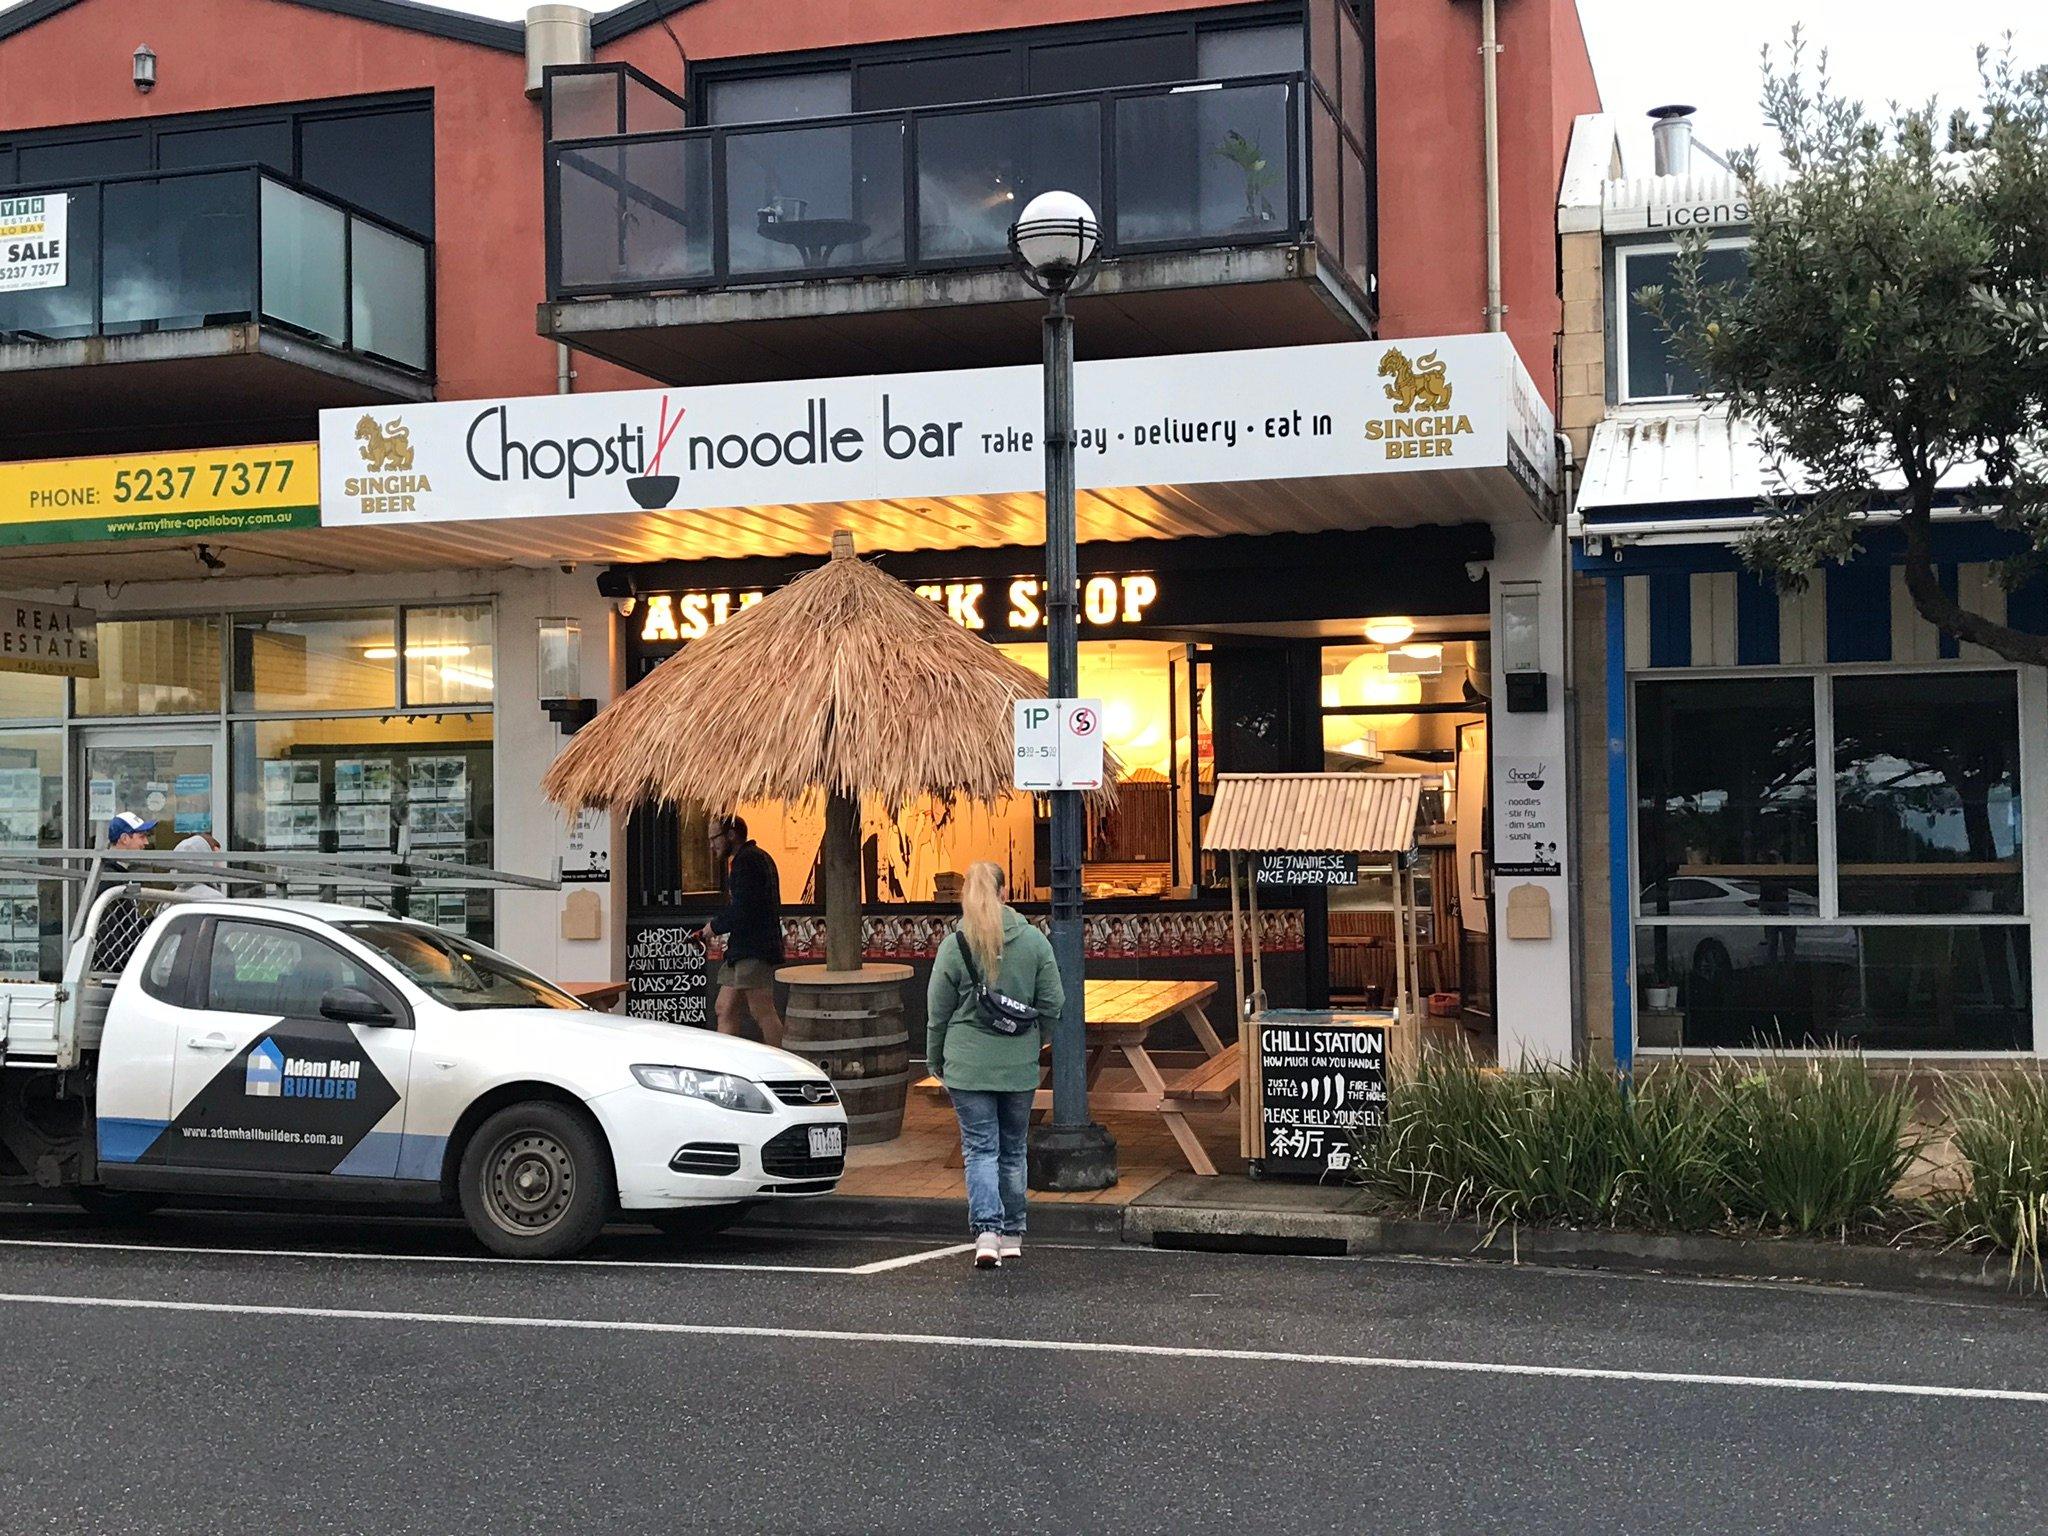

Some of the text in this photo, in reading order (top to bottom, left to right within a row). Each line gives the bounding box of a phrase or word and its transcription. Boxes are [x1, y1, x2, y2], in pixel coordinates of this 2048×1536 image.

[4, 214, 46, 226] ESTATE
[21, 222, 44, 234] BAY
[8, 239, 60, 262] SALE
[0, 262, 59, 280] 5237 7377
[689, 397, 864, 470] noodle
[882, 393, 963, 461] bar
[981, 426, 1033, 454] Take
[1265, 409, 1302, 438] Eat
[1313, 413, 1332, 436] in
[1364, 414, 1474, 440] SINGHA
[1385, 437, 1454, 460] BEER
[29, 459, 295, 508] PHONE: 5237 7377
[344, 474, 432, 498] SINGHA
[360, 496, 416, 514] BEER
[107, 511, 292, 533] www.smythre-apollobay.com.au
[16, 607, 73, 634] REAL
[3, 630, 88, 659] ESTATE
[1023, 708, 1050, 729] 1P
[1508, 798, 1541, 806] noodles
[1508, 809, 1536, 819] stir fry
[1508, 820, 1546, 829] dim sum
[1508, 832, 1532, 841] sushi
[1262, 854, 1345, 869] VIETNAMESE
[1256, 870, 1357, 885] RICE PAPER ROLL
[637, 926, 692, 943] CHOPSTIX
[627, 940, 707, 958] UNDERGROUND
[628, 977, 637, 992] 7
[639, 977, 666, 992] DAYS
[1000, 994, 1027, 1013] FACE
[1262, 1030, 1383, 1054] CHILLI STATION
[284, 1058, 361, 1079] Adam Hall
[1263, 1056, 1380, 1070] HOW MUCH CAN YOU HANDLE
[283, 1077, 358, 1100] BUILDER
[1267, 1088, 1299, 1097] LITTLE
[1268, 1079, 1297, 1088] JUST A
[1350, 1080, 1381, 1091] FIRE IN
[1347, 1091, 1364, 1101] THE
[1264, 1107, 1300, 1124] PLEASE
[1303, 1110, 1329, 1125] HELP
[182, 1126, 343, 1146] www.adamhallbuilders.com.au
